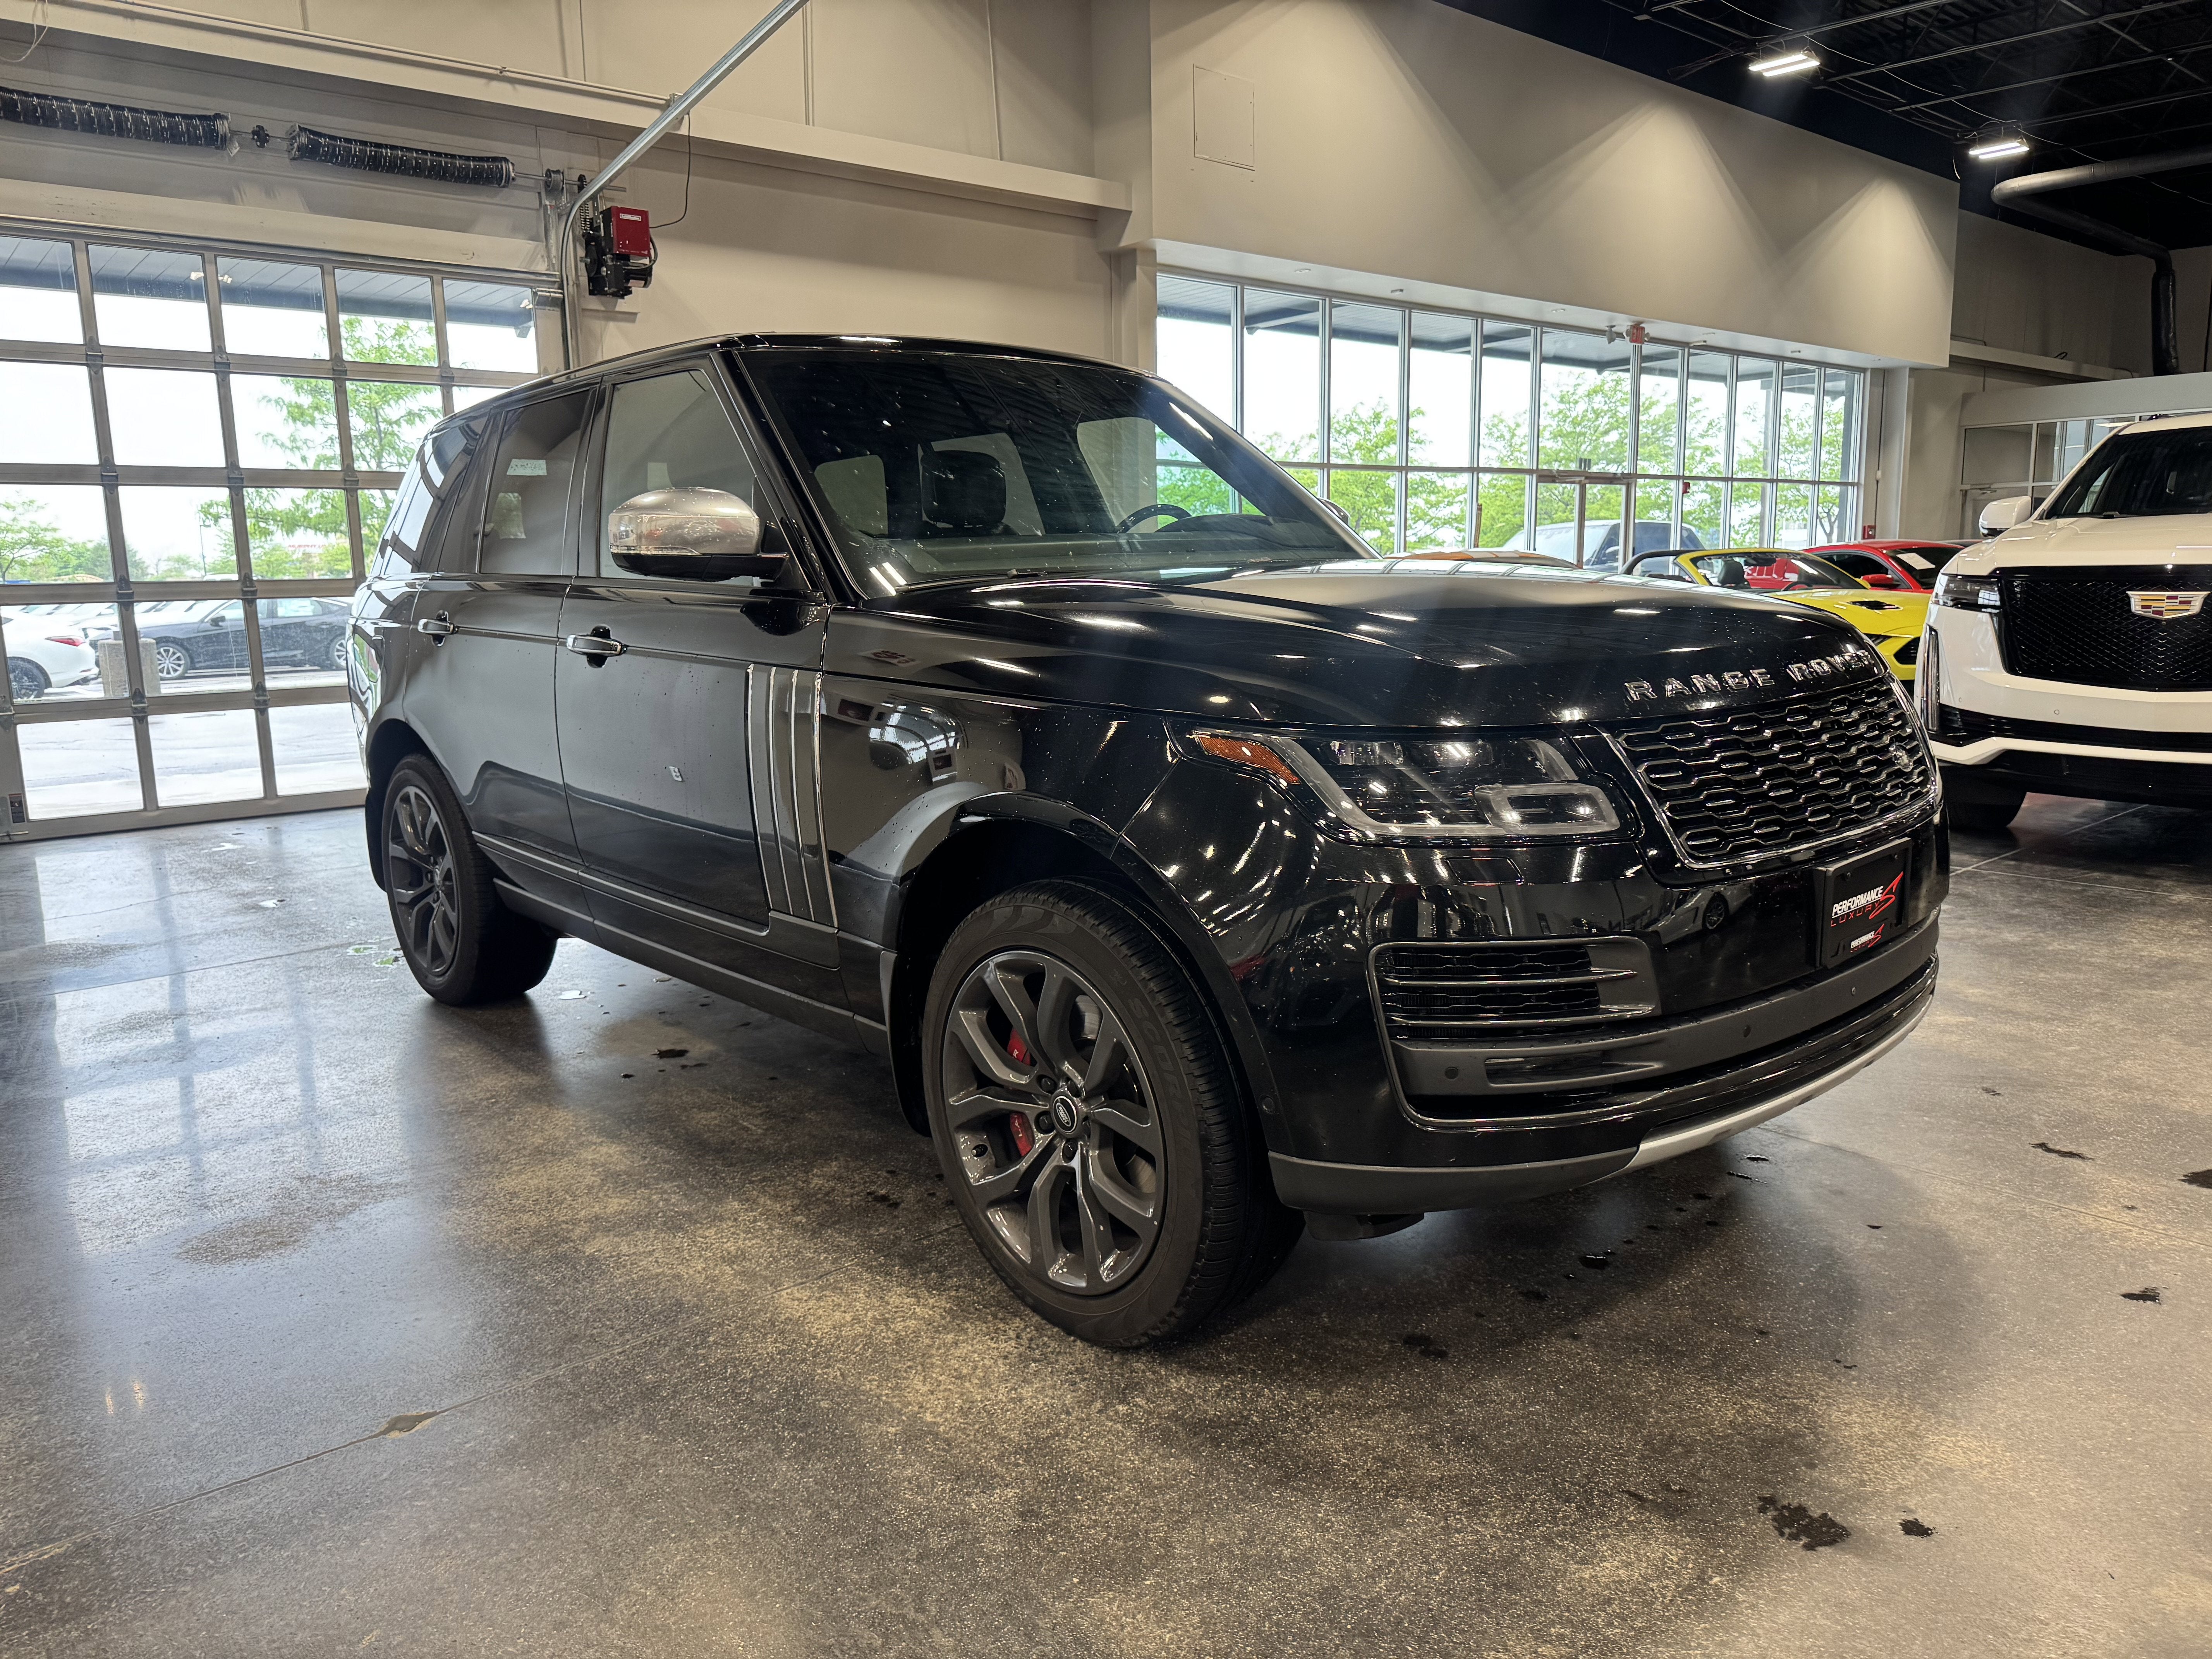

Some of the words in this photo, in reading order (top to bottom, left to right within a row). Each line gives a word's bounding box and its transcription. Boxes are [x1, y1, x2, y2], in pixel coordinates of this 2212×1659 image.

[1625, 668, 1775, 702] RANGE
[1831, 901, 1885, 927] LUXURY
[1832, 885, 1884, 917] PERFORMANCE
